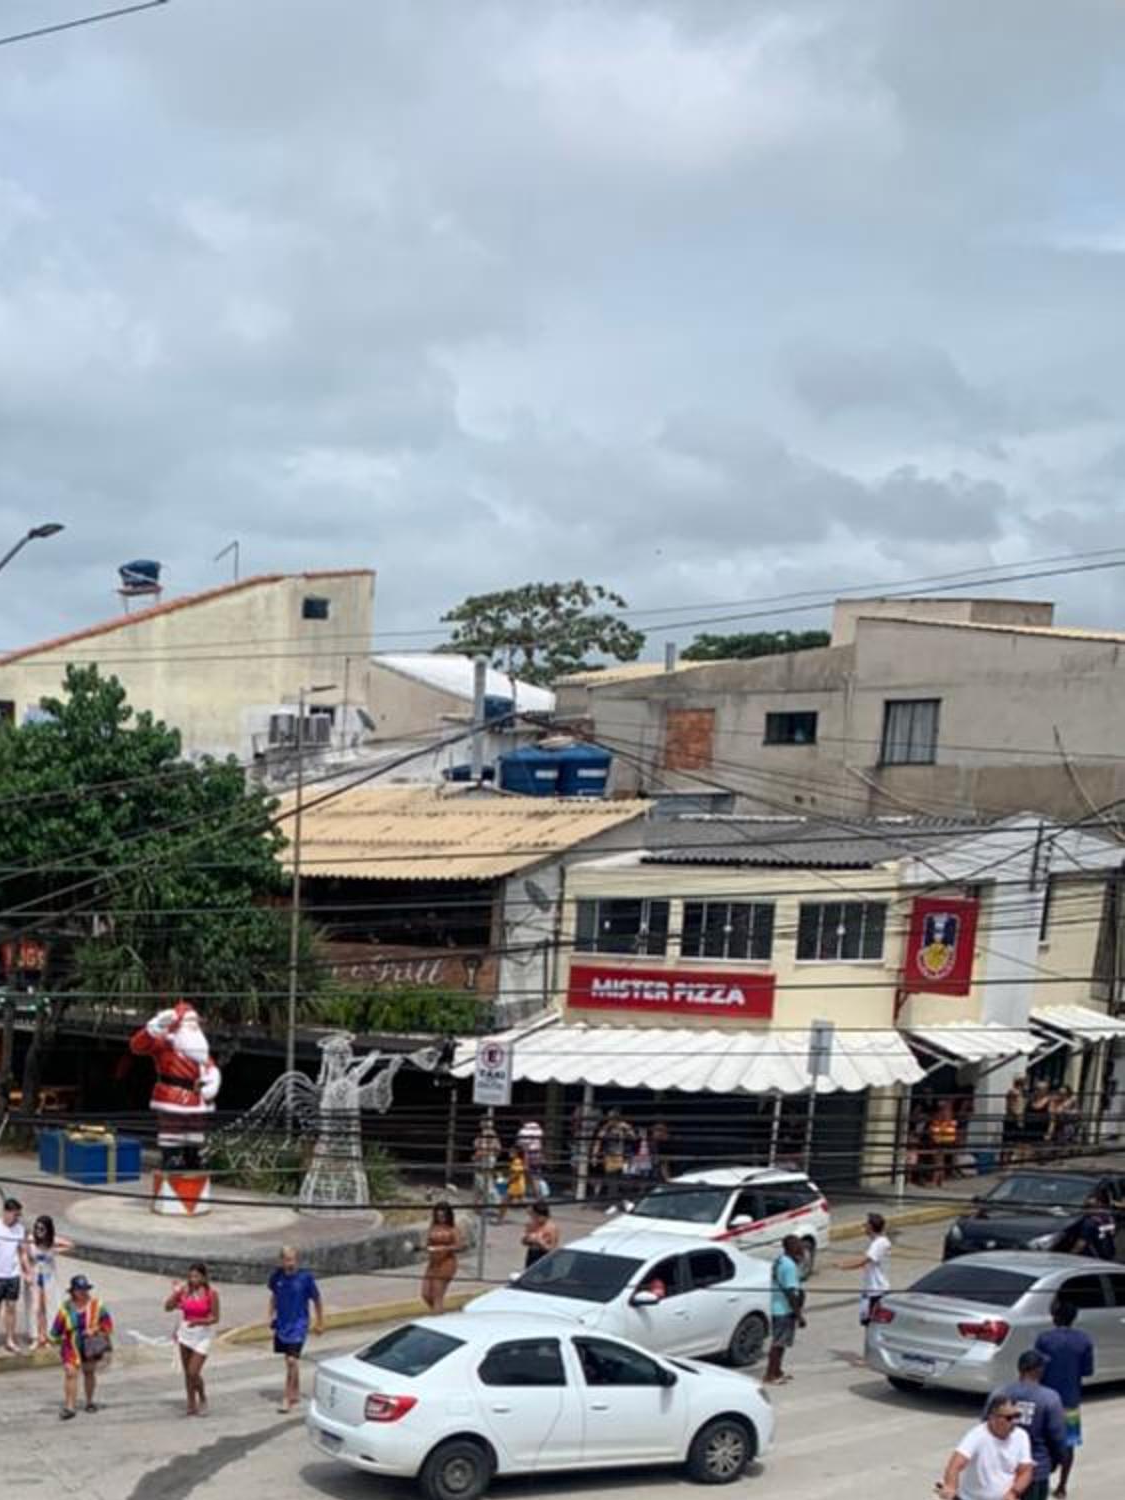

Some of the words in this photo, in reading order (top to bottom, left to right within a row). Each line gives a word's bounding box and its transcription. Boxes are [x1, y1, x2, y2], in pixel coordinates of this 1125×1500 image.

[591, 977, 670, 1001] MISTER
[674, 982, 746, 1006] PIZZA
[488, 1049, 498, 1063] E
